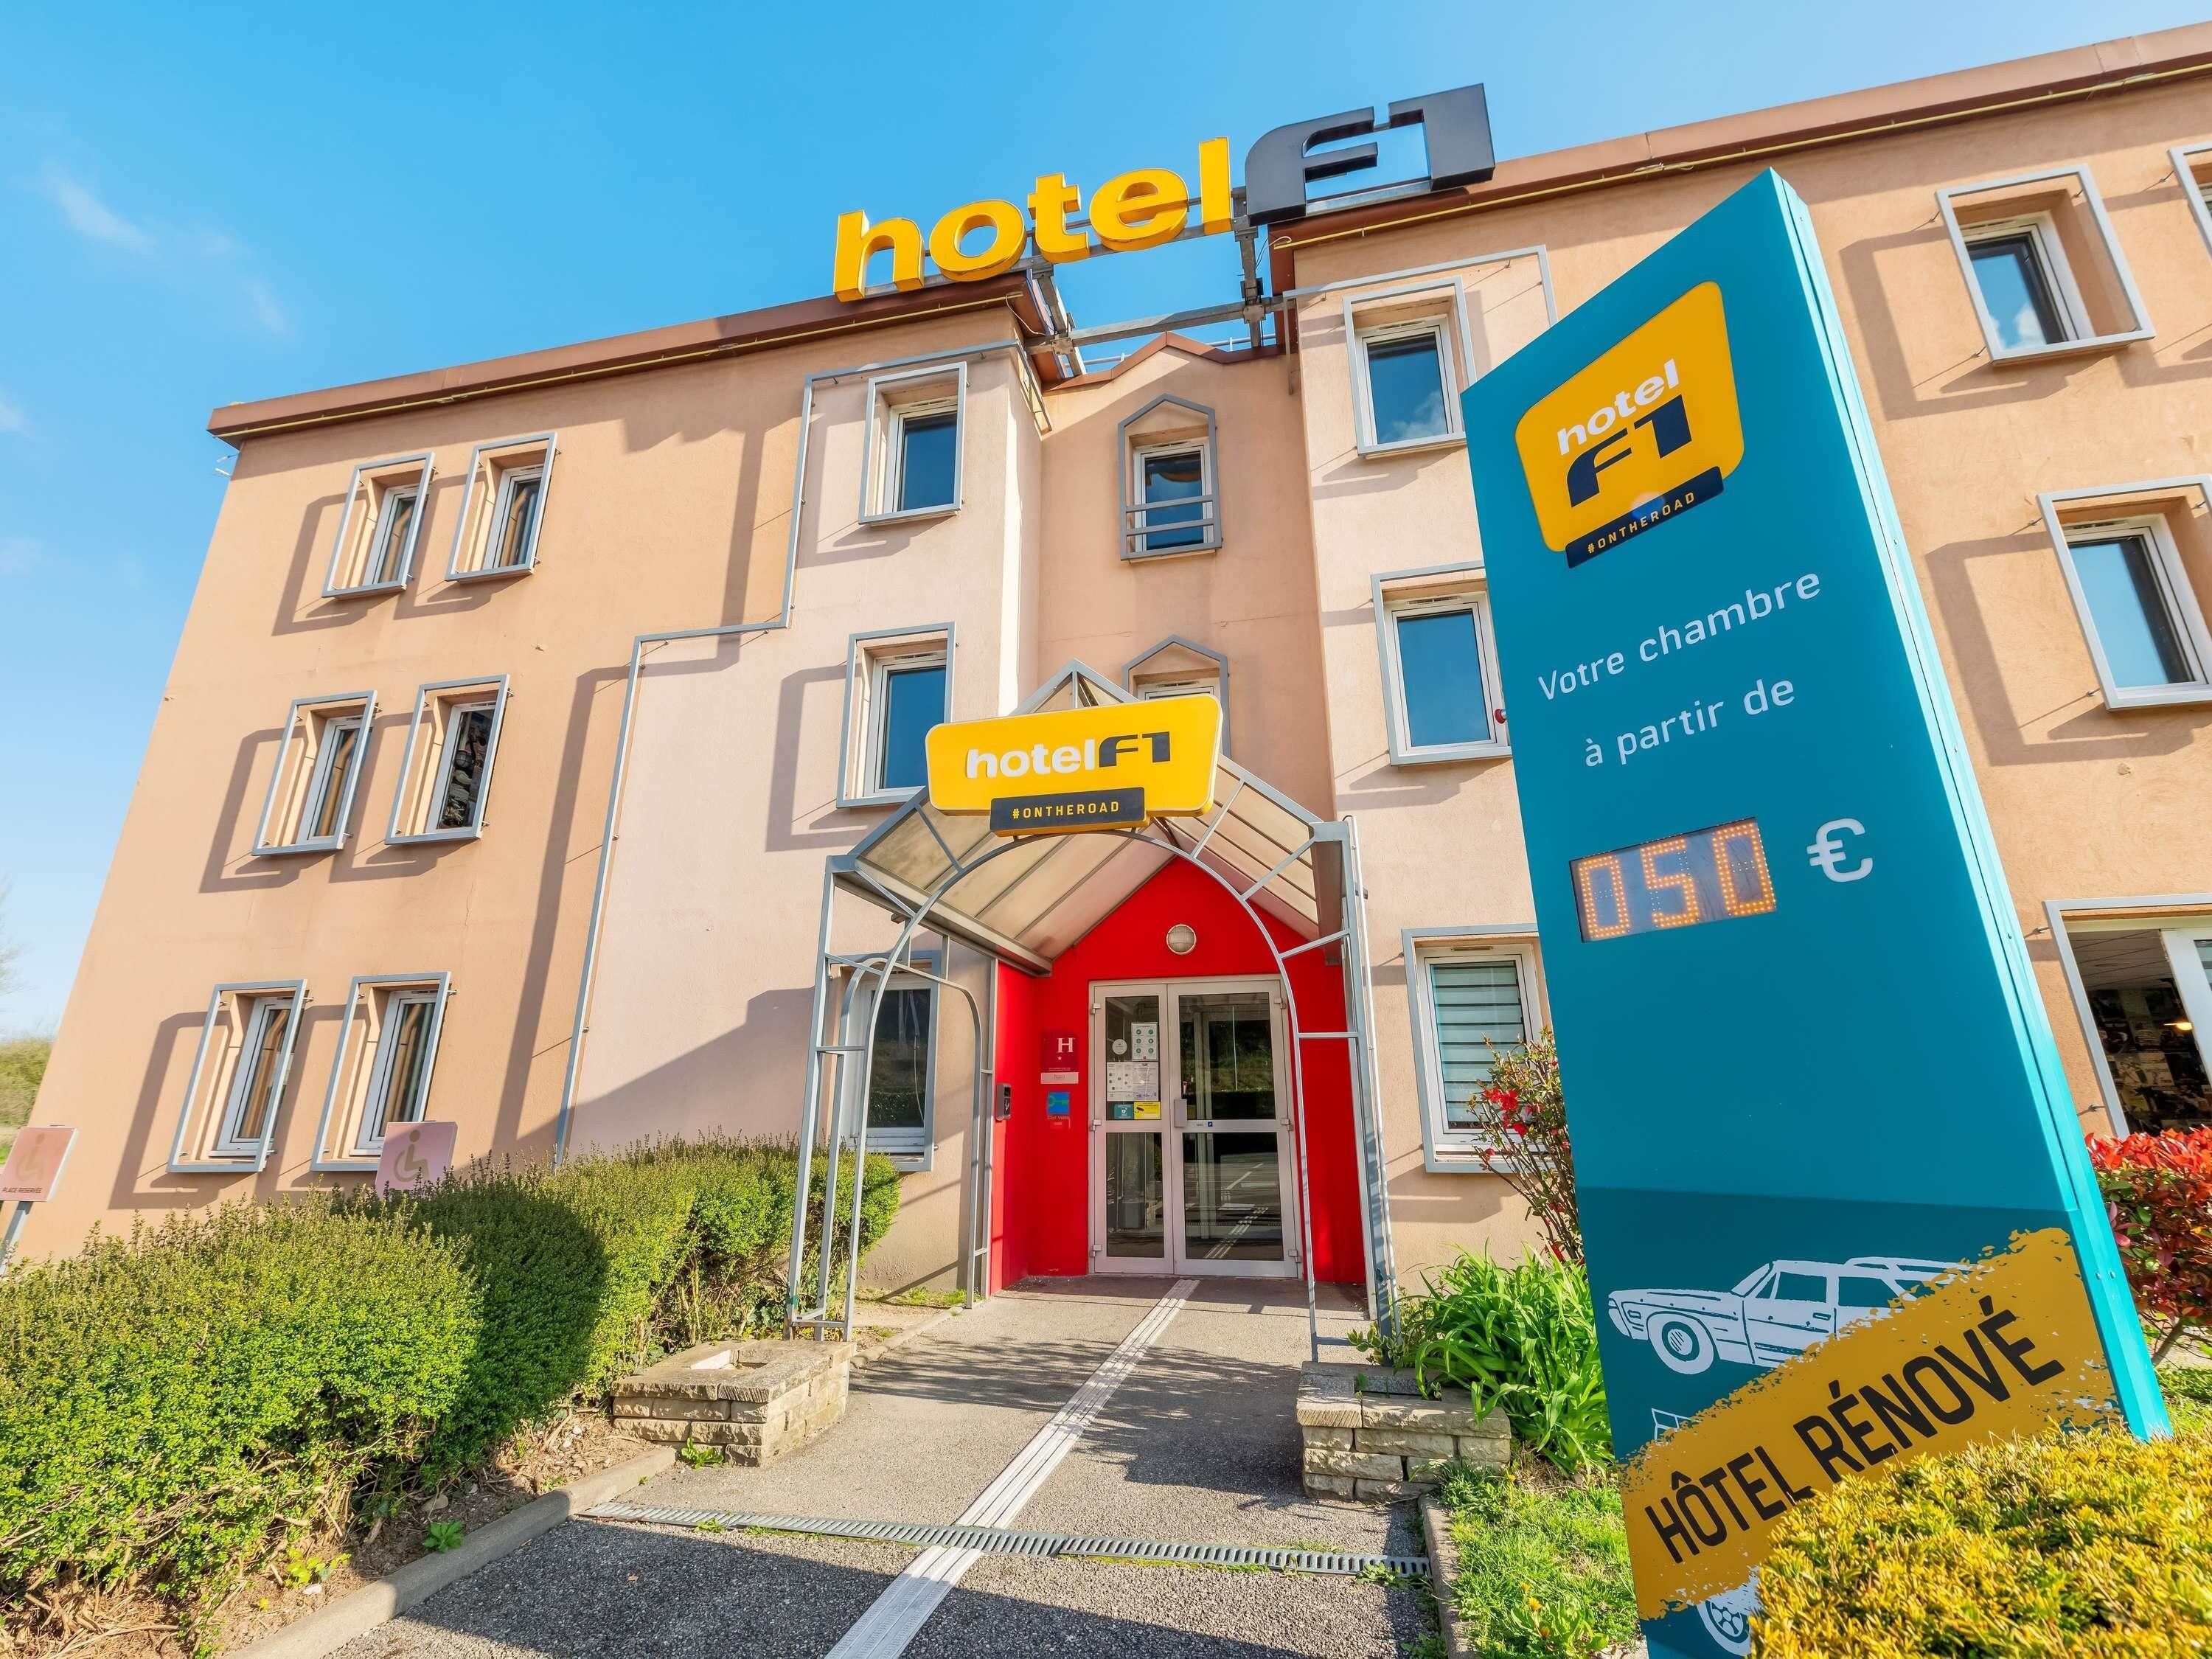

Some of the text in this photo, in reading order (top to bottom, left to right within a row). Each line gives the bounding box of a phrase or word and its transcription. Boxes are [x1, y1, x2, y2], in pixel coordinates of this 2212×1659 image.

[1557, 358, 1680, 456] hotel
[1566, 394, 1692, 507] F1
[1586, 492, 1696, 554] #ONTHEROAD
[1537, 572, 1821, 700] Votre chambre
[1585, 678, 1795, 767] à partir de
[1012, 801, 1121, 819] #ONTHEROAD
[1579, 821, 1777, 938] 050
[1057, 1037, 1075, 1053] H
[1646, 1295, 2065, 1564] HÔTEL RÉNOVÉ
